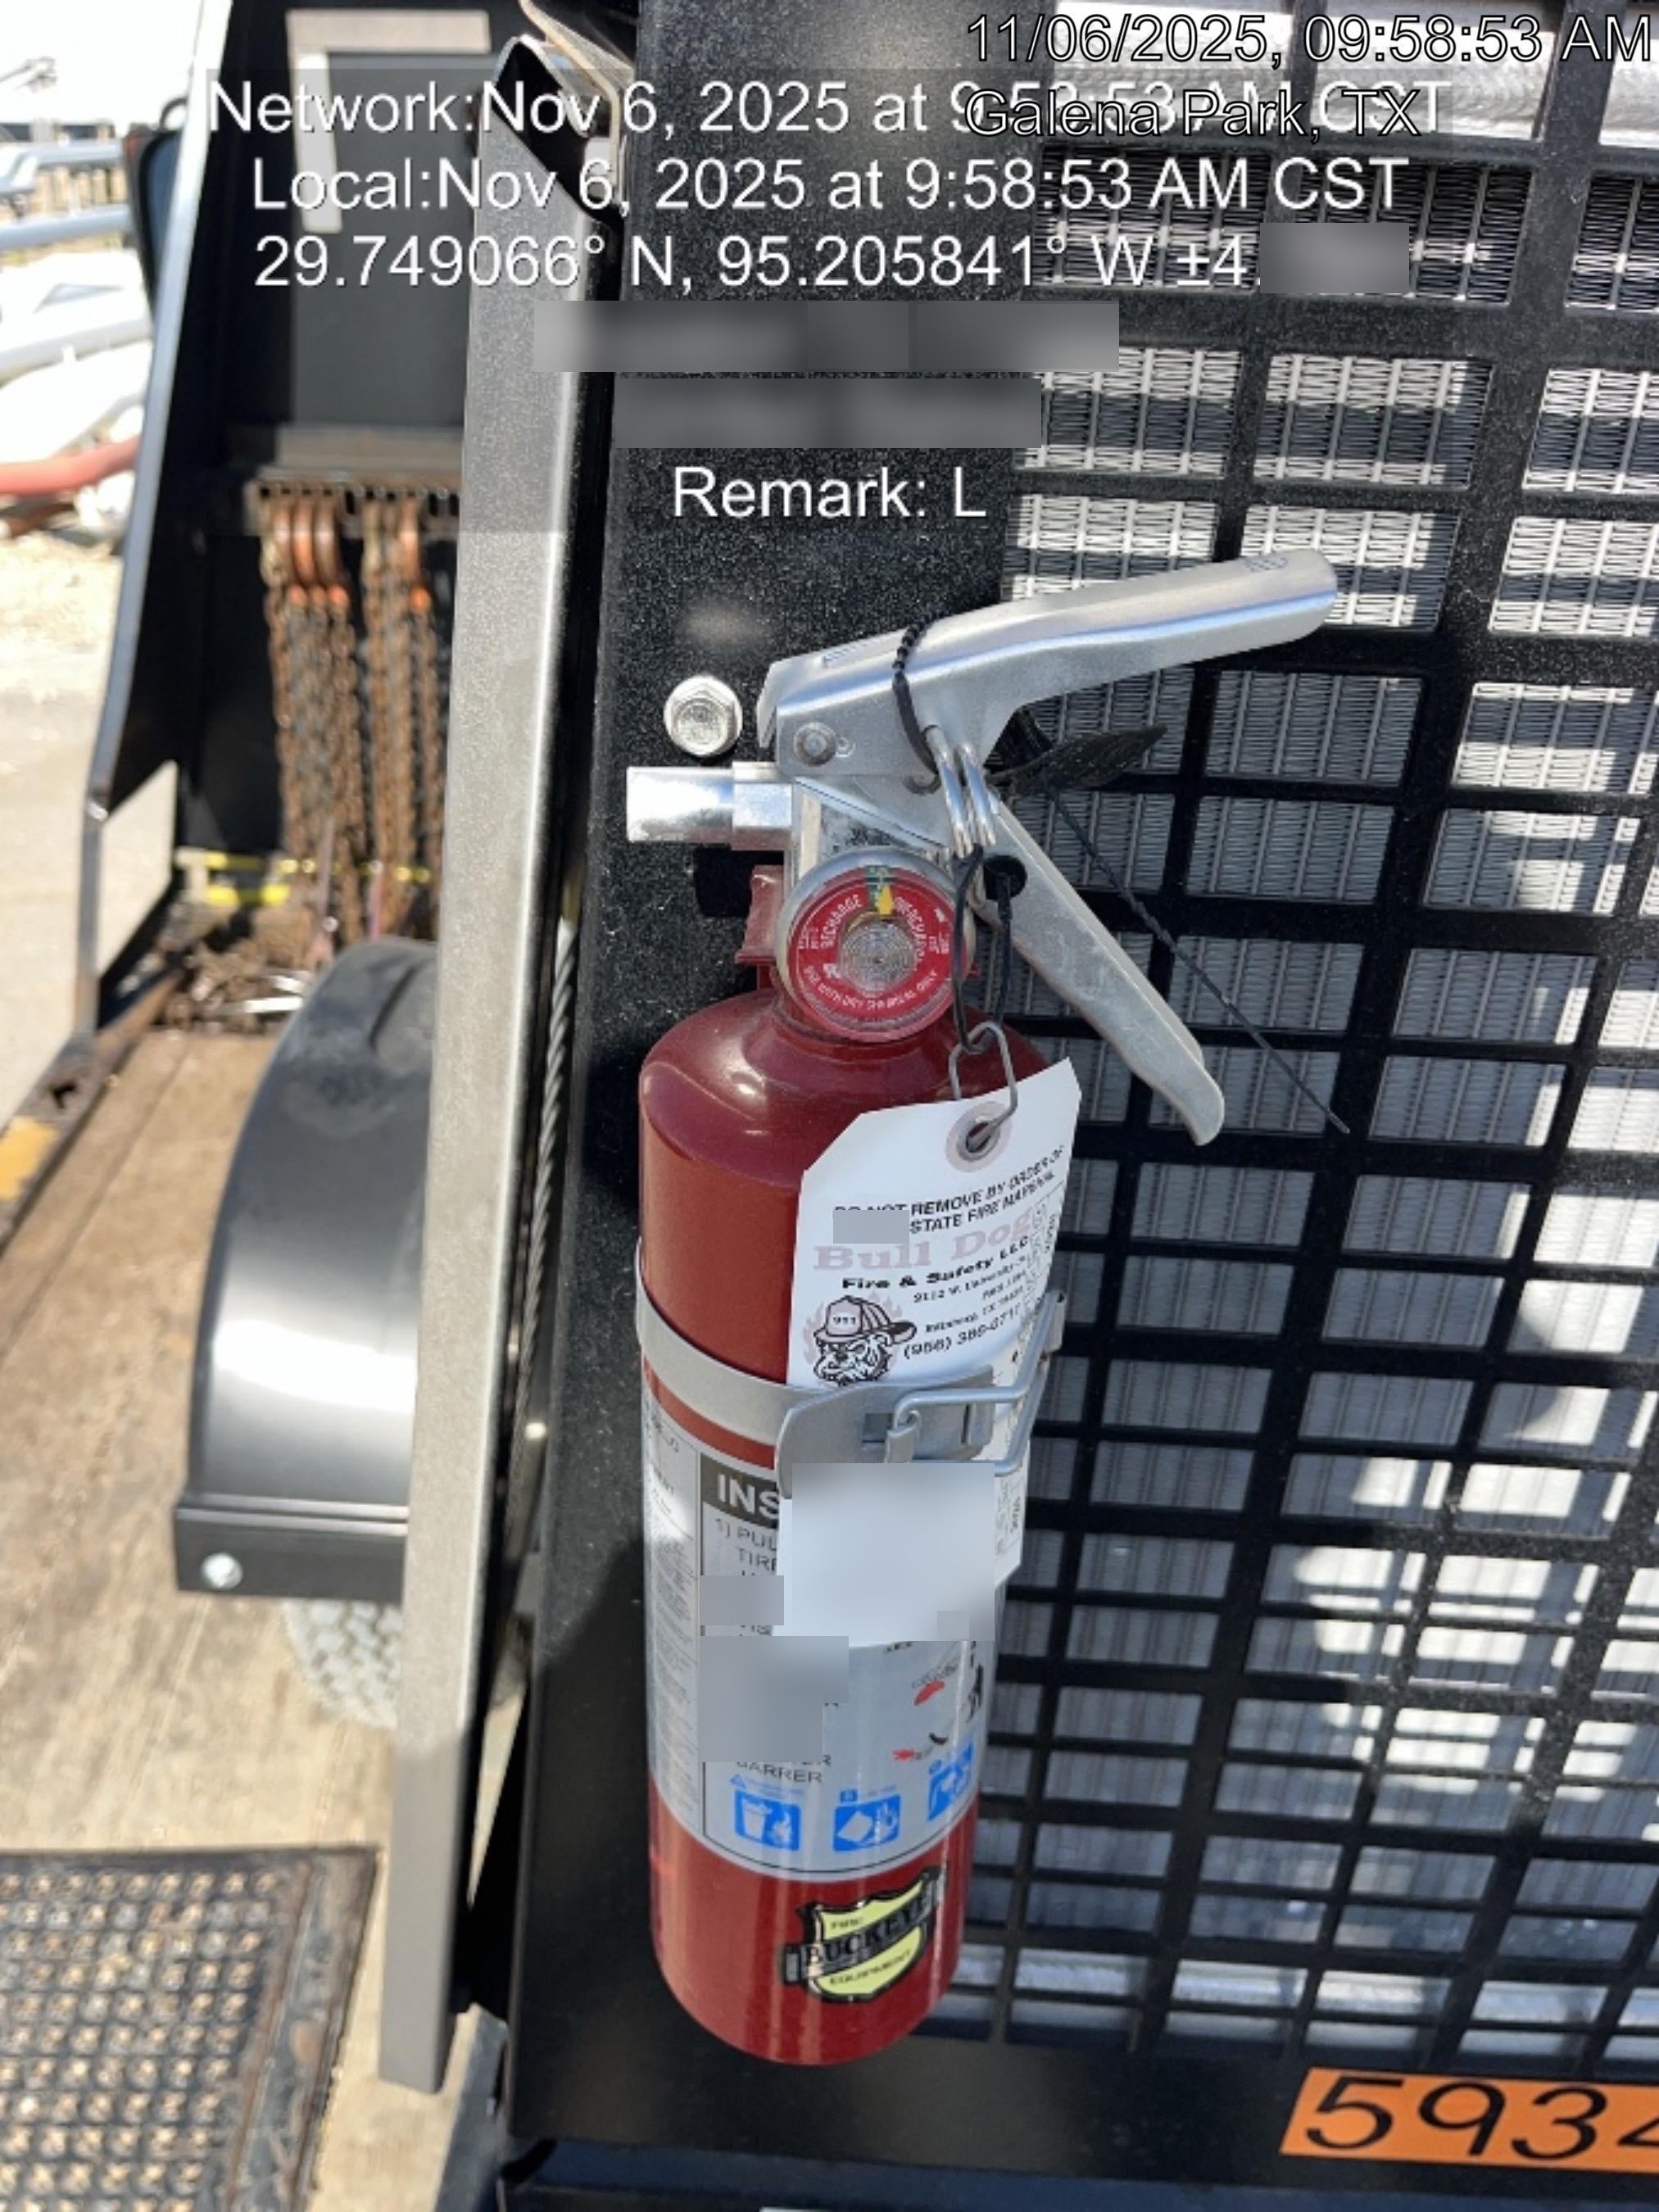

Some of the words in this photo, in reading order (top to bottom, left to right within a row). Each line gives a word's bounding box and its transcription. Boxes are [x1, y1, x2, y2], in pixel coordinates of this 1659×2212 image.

[911, 1190, 981, 1217] REMOVE
[986, 1181, 1006, 1200] BY
[909, 1213, 962, 1235] STATE
[967, 1199, 1000, 1223] FIRE
[813, 1240, 931, 1271] Bull
[842, 1277, 891, 1290] Fire
[926, 1257, 994, 1284] Safety
